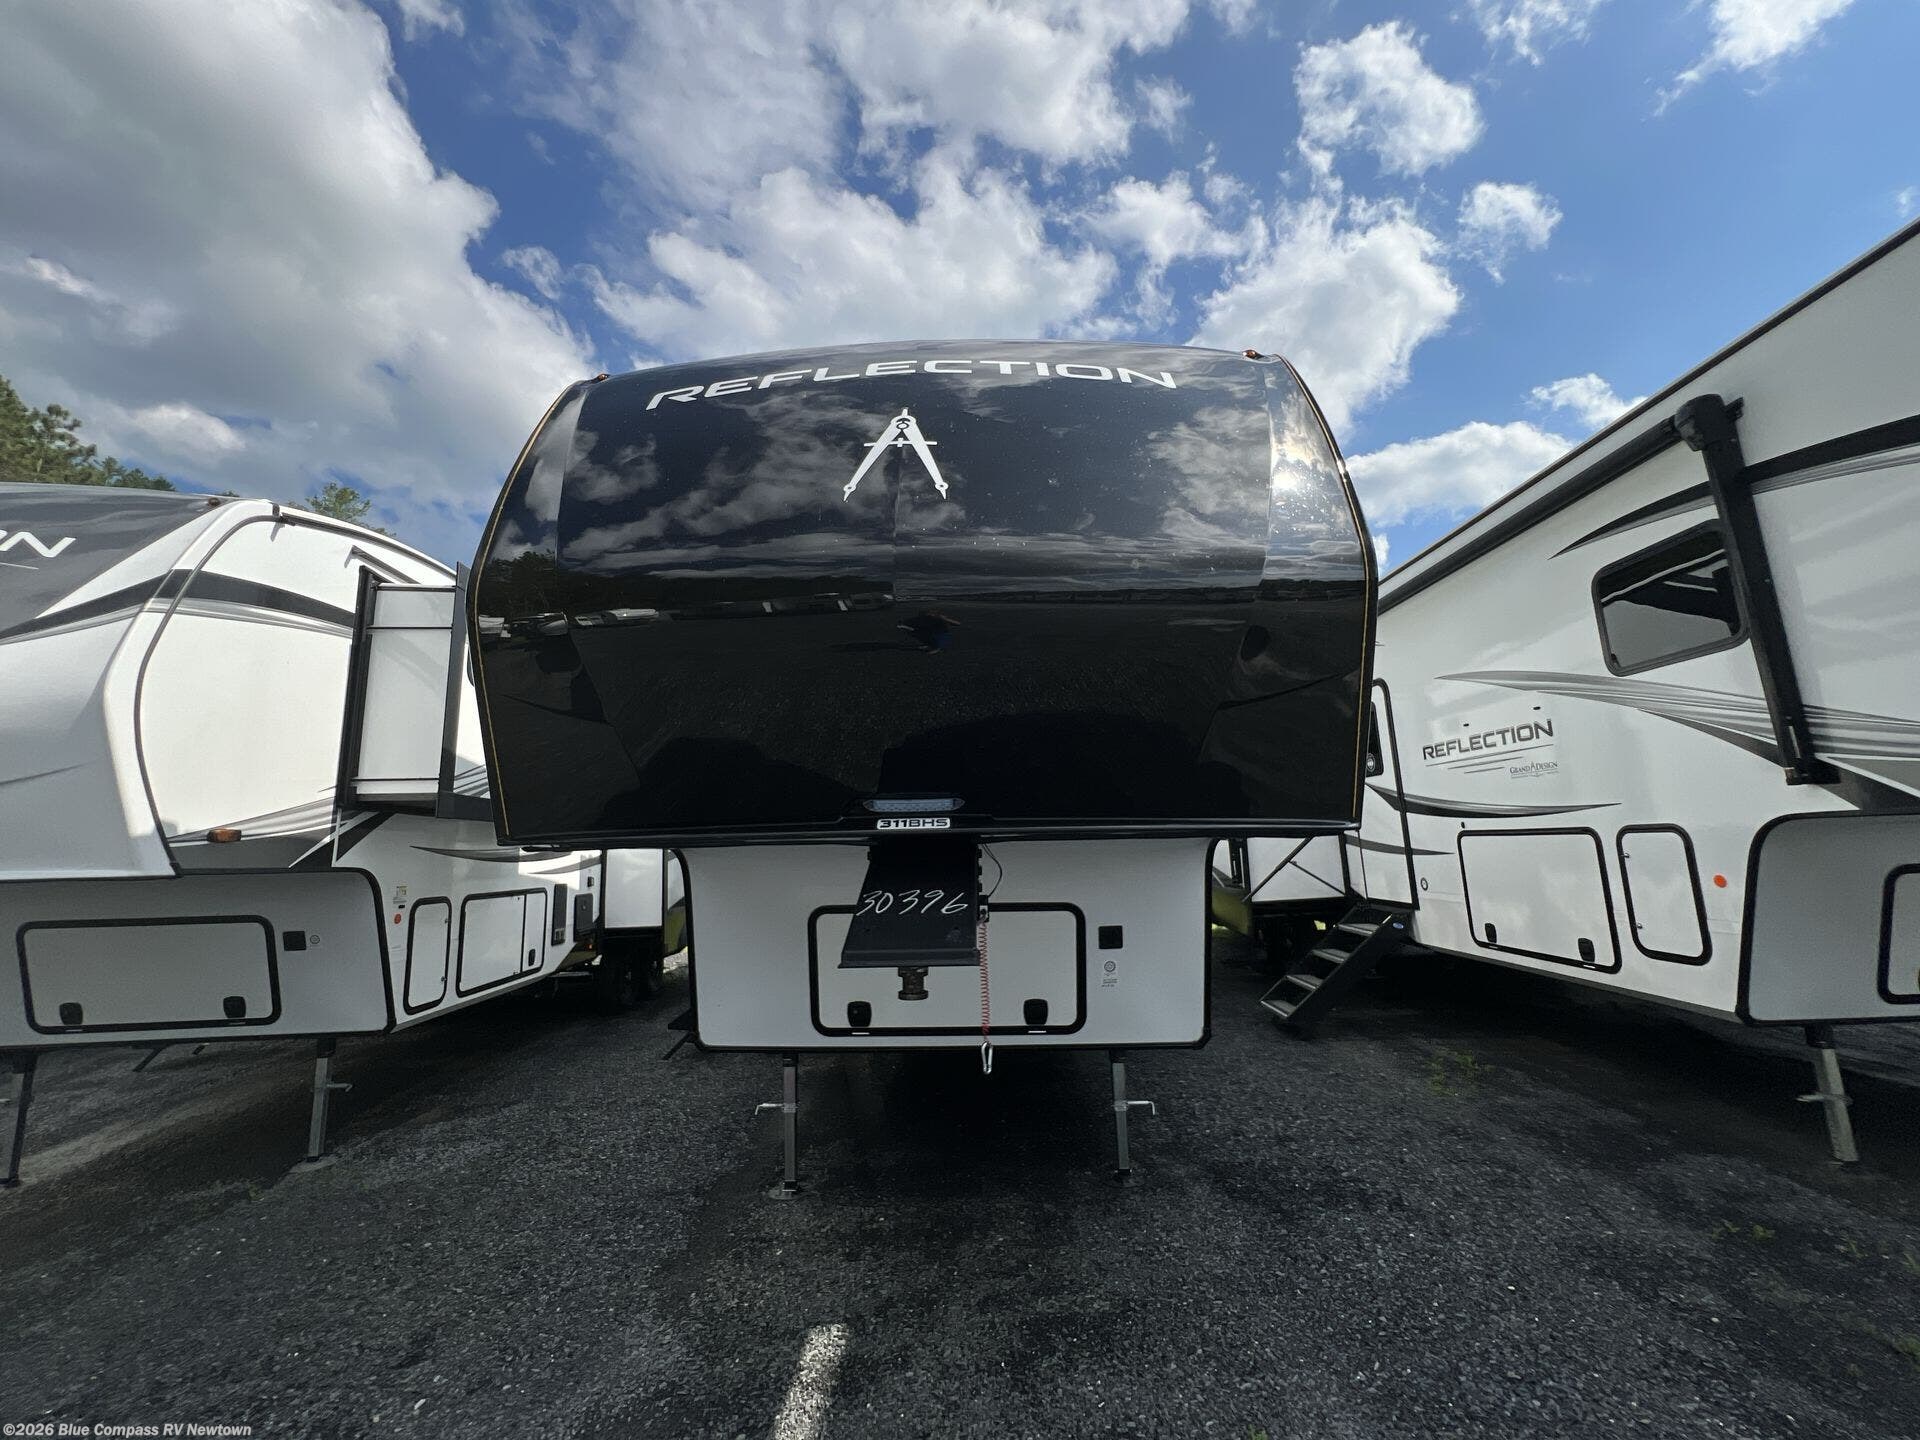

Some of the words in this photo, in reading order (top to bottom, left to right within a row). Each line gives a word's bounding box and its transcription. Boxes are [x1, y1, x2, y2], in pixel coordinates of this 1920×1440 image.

[645, 359, 1178, 411] REFLECTION
[0, 529, 77, 558] N
[1422, 718, 1554, 760] REFLECTION
[879, 818, 949, 829] 311BHS
[856, 889, 969, 917] 30396
